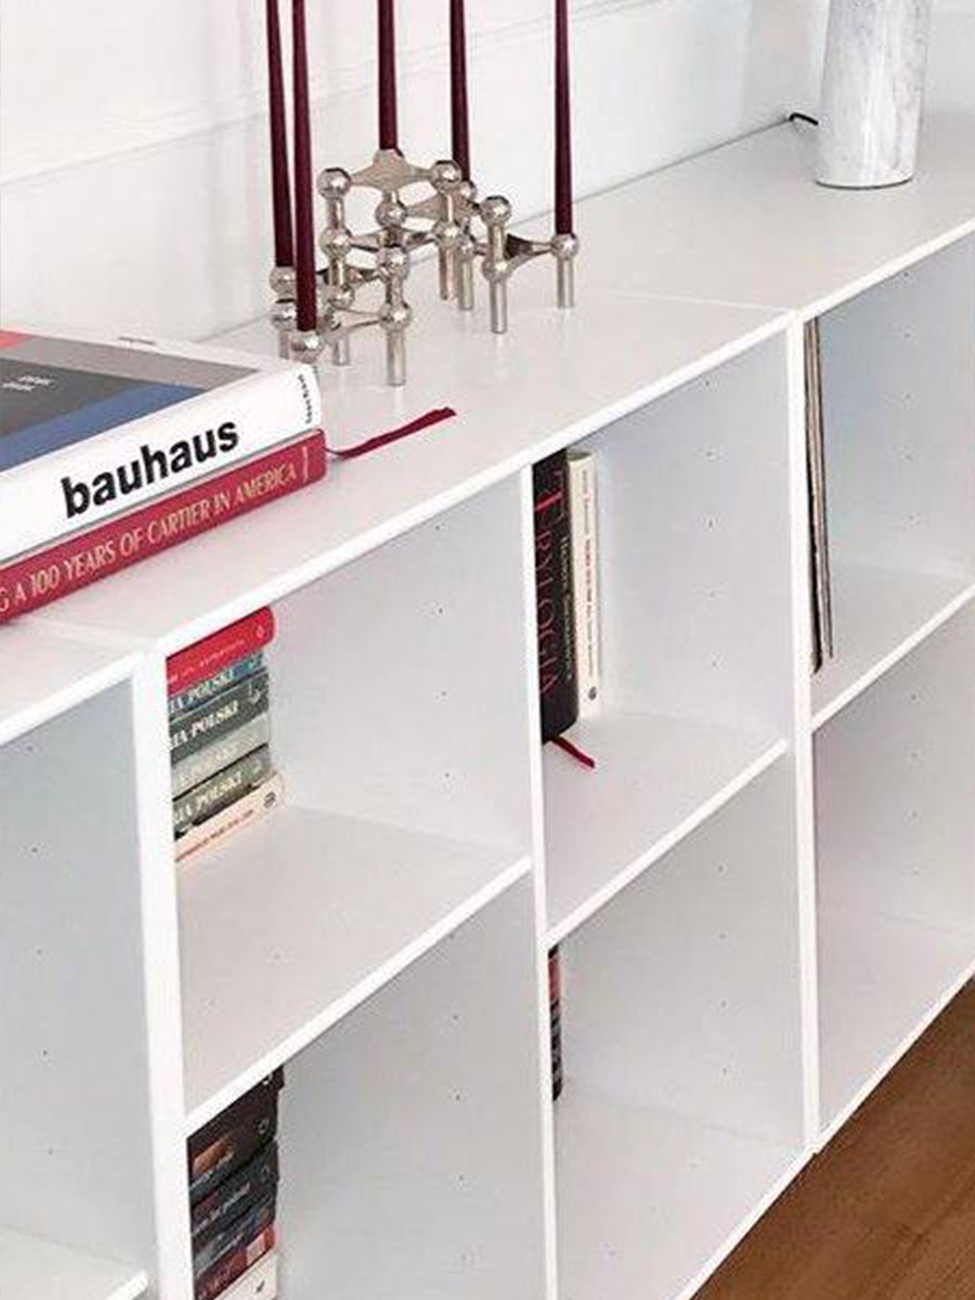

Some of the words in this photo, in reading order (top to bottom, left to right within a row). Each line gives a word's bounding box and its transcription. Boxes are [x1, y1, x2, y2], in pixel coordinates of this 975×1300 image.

[61, 420, 239, 518] bauhaus
[10, 582, 28, 604] A
[29, 564, 61, 595] 100
[63, 541, 115, 583] YEARS
[119, 529, 145, 558] OF
[146, 500, 212, 545] CARTIER
[211, 492, 230, 517] IN
[225, 468, 297, 509] AMERICA
[190, 699, 239, 736] POLSKI
